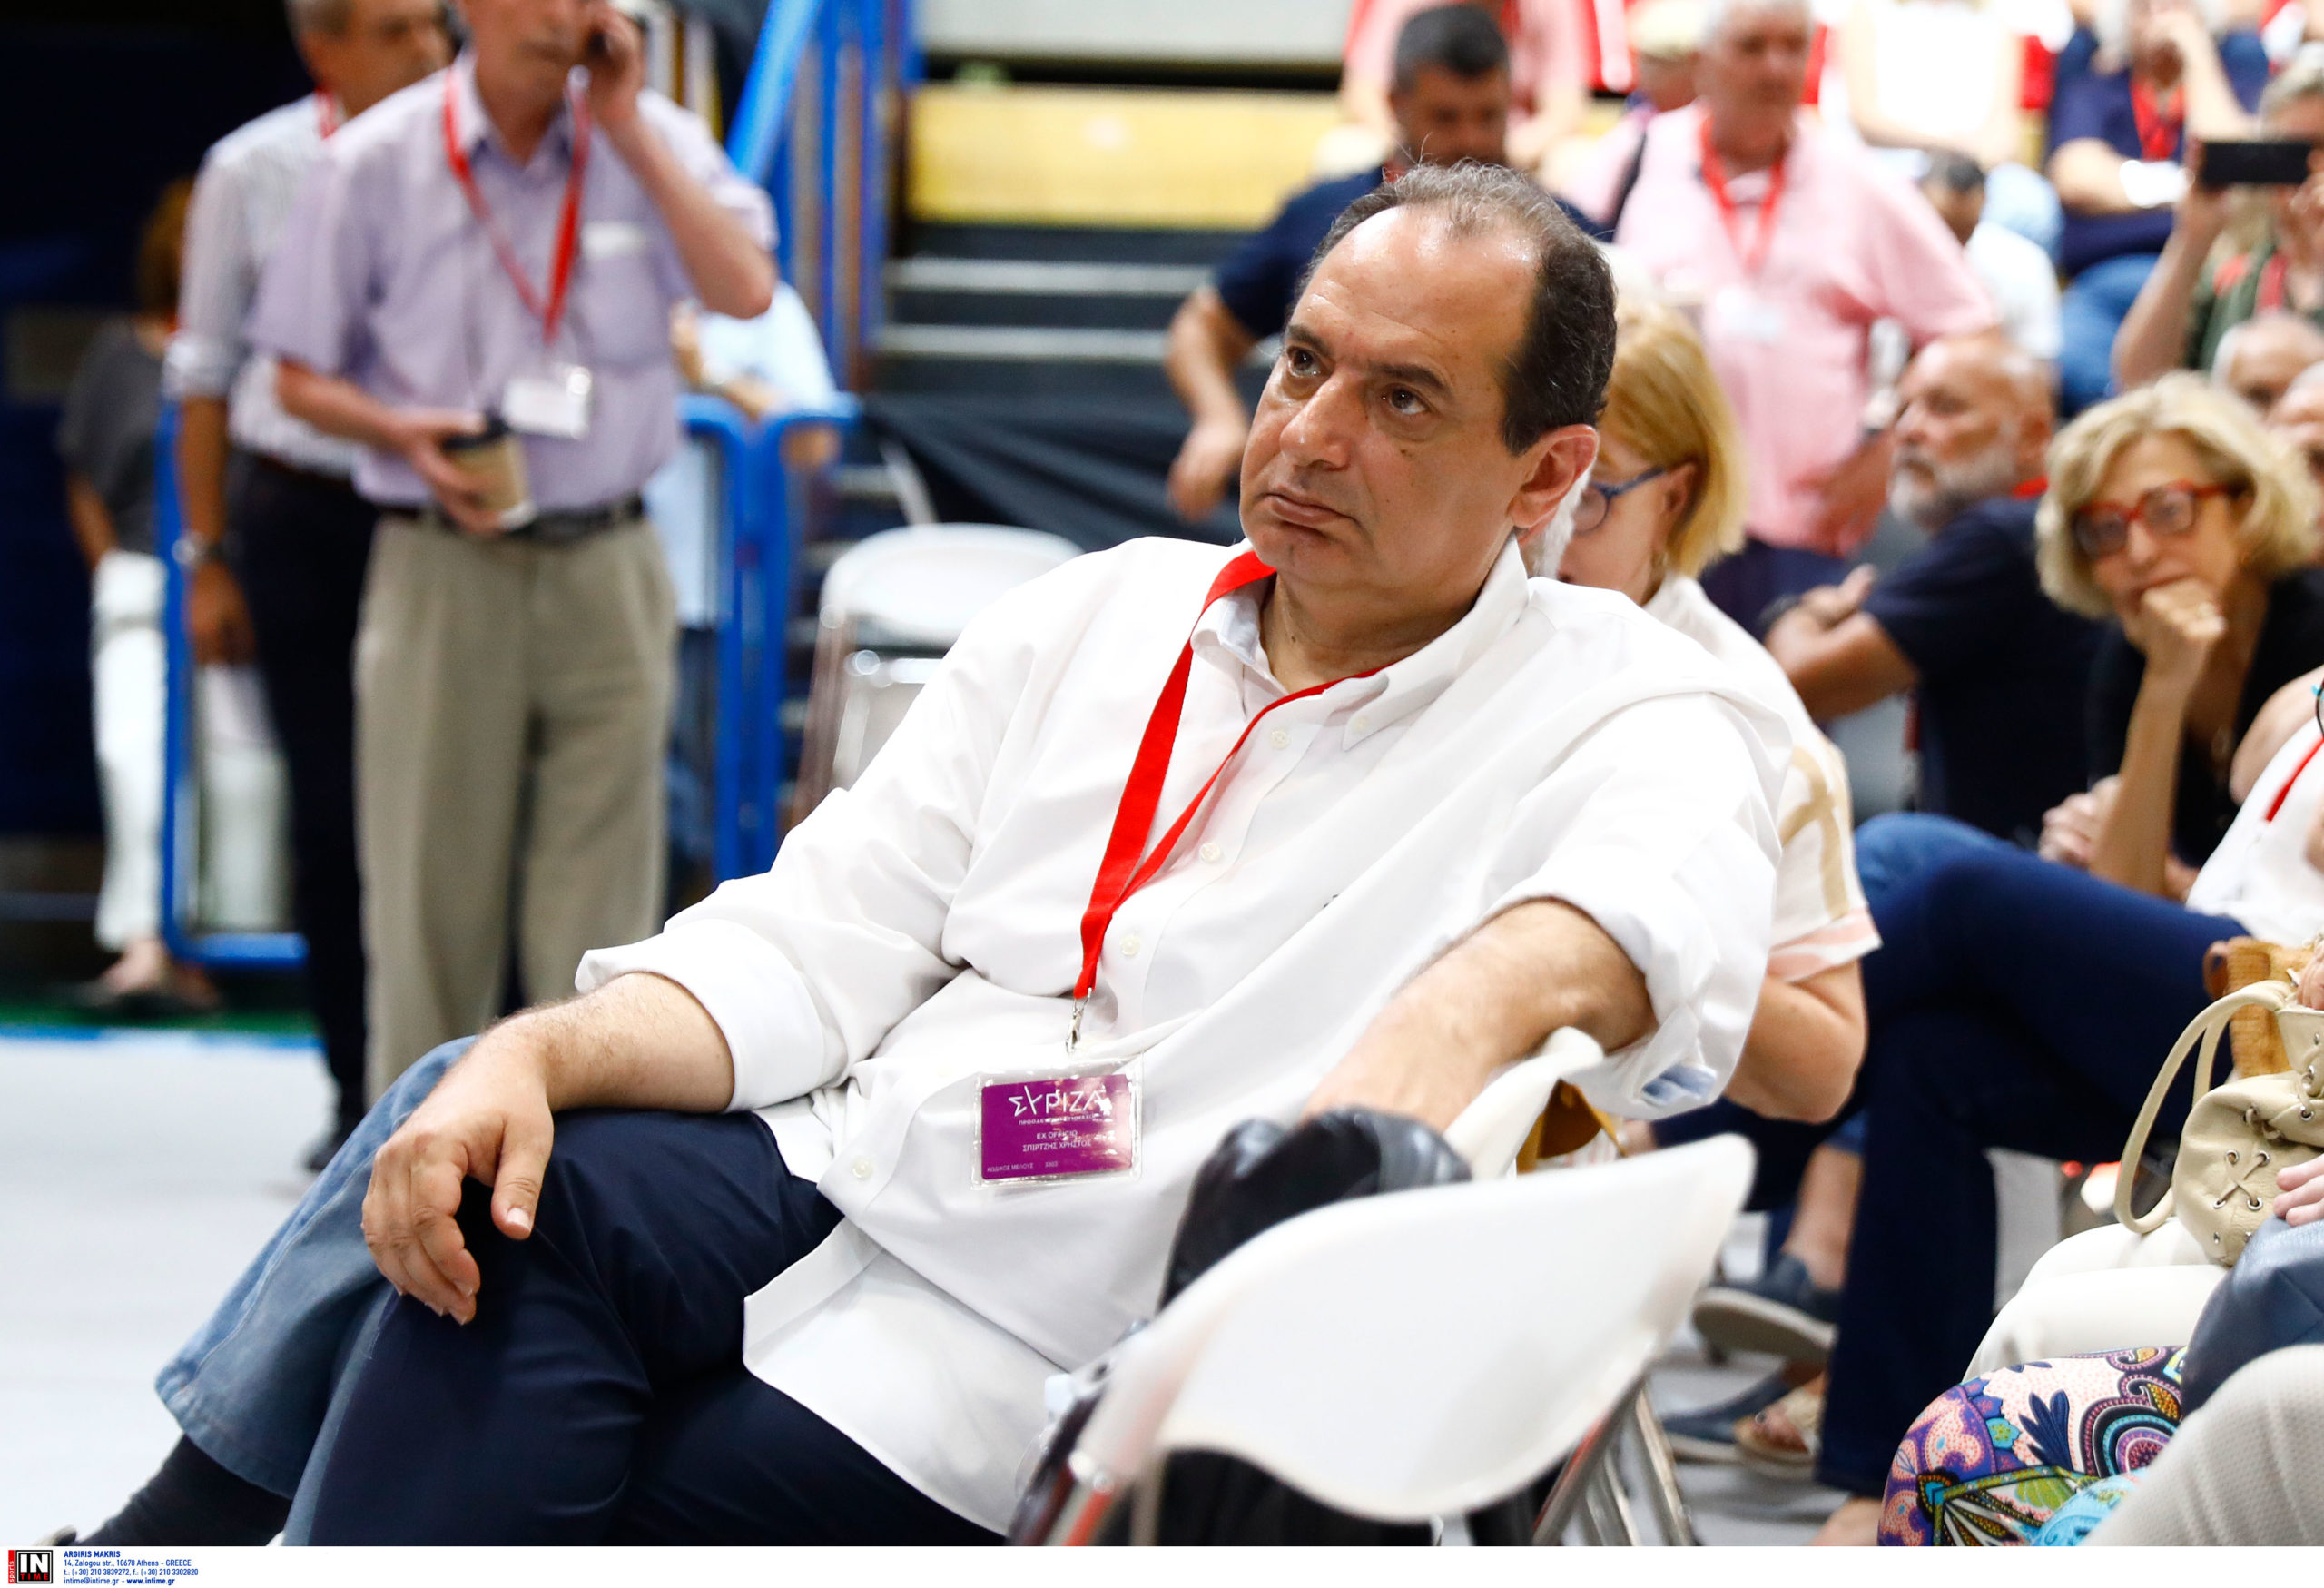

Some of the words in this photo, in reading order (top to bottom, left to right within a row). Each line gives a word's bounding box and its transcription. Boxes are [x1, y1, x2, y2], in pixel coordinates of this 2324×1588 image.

[1008, 1085, 1106, 1117] ΣΥΡΙΖΑ
[1037, 1132, 1047, 1140] EX
[1022, 1141, 1058, 1152] ΣΠΙΡΤΖΗΣ
[1059, 1139, 1092, 1149] ΧΡΗΣΤΟΣ
